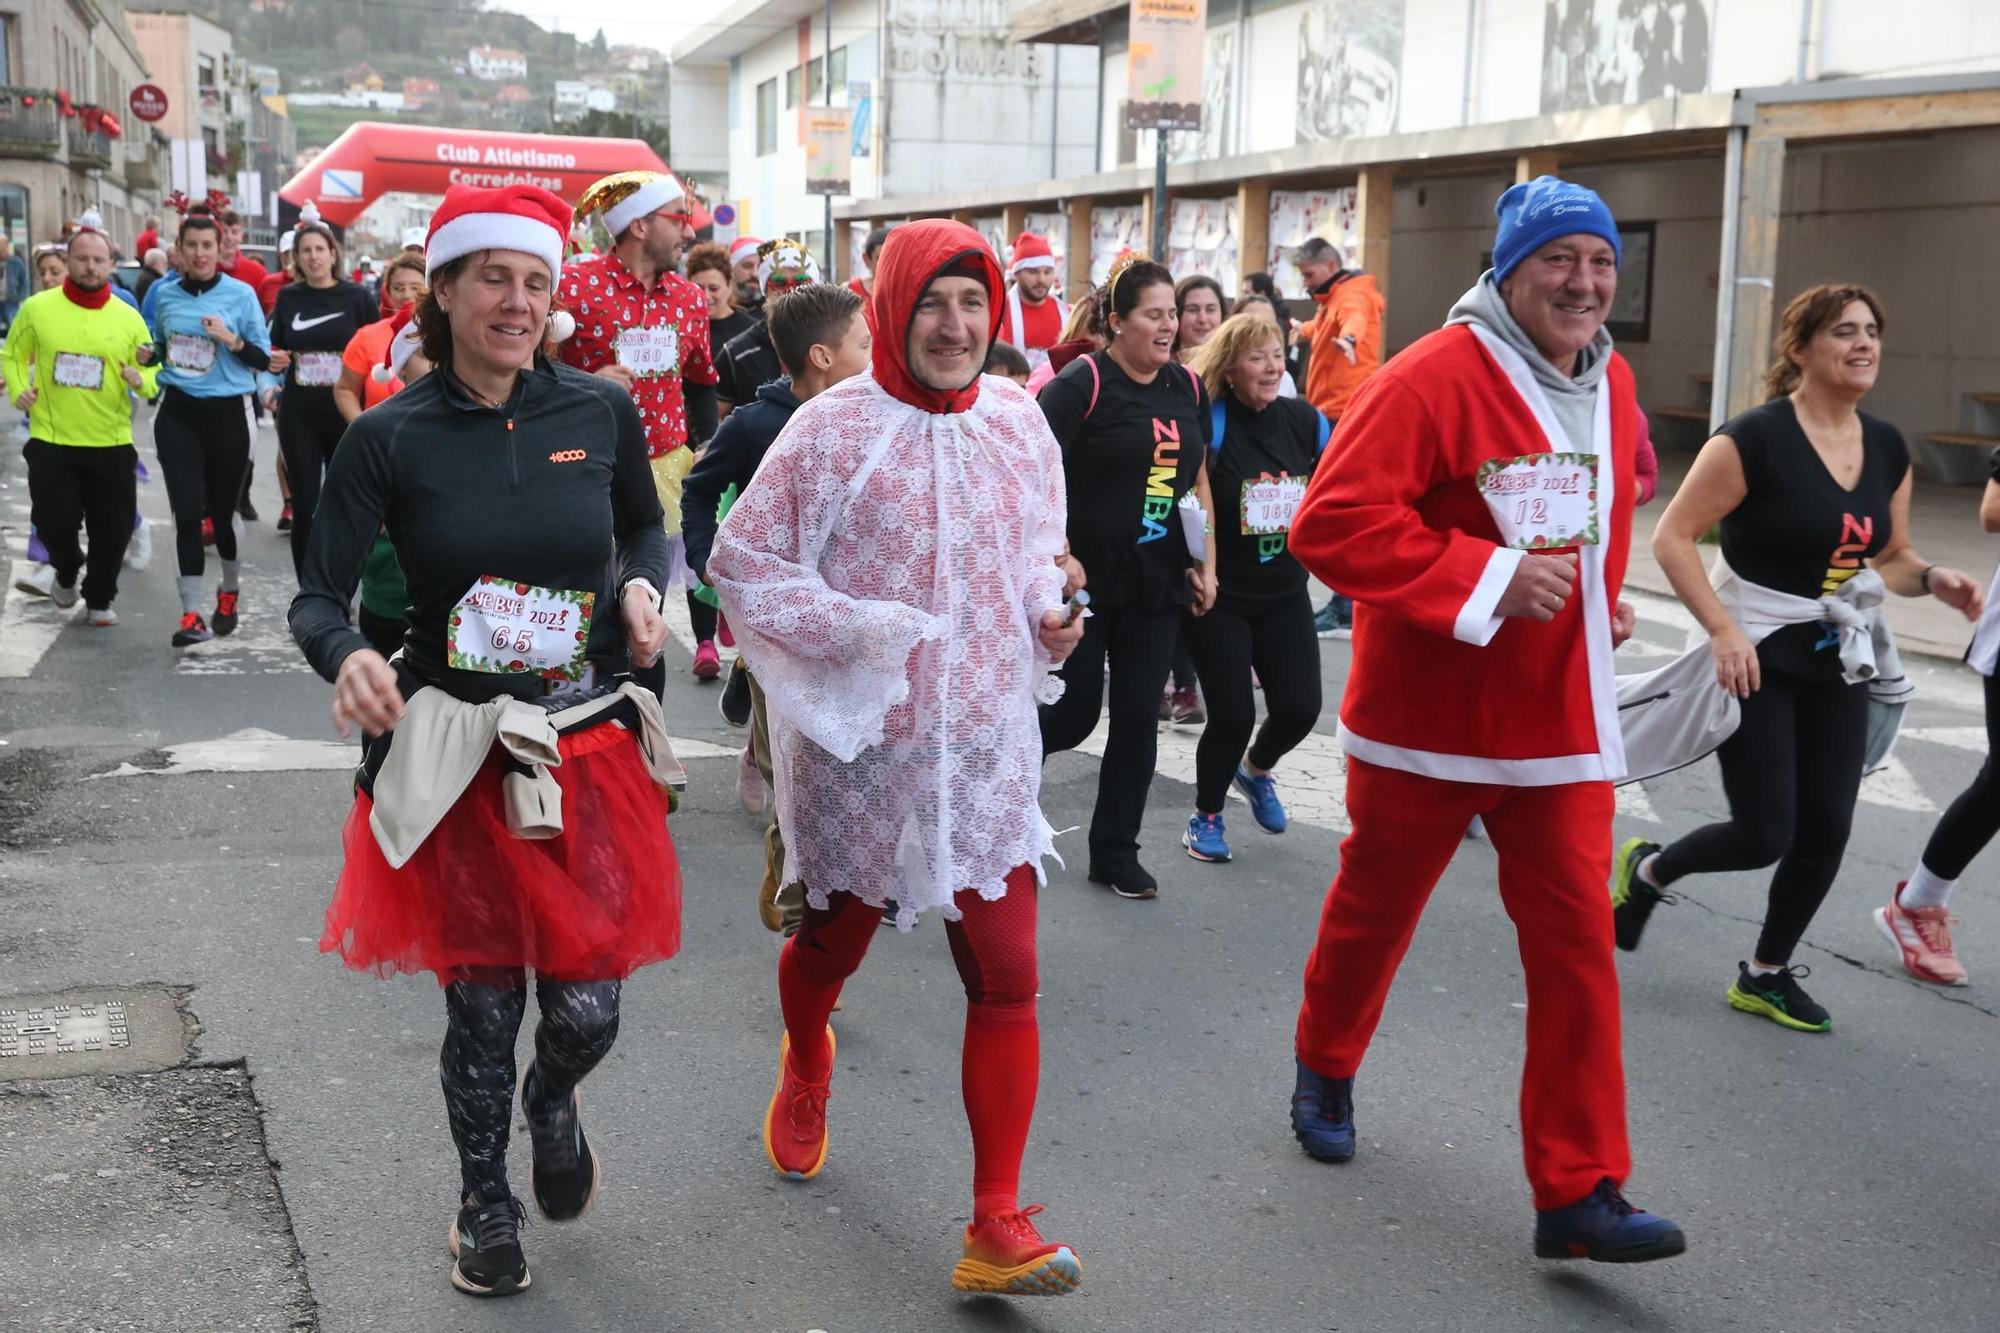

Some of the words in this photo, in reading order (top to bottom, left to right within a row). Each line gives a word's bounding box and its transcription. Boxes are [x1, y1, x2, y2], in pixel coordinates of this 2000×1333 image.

[895, 49, 949, 75] DO
[956, 49, 1042, 78] MAR
[436, 143, 480, 162] Club
[484, 147, 576, 168] Atletismo
[449, 169, 562, 191] Corredoiras
[633, 348, 662, 363] 150
[1137, 417, 1181, 544] ZUMBA
[1543, 473, 1580, 490] 2023
[1515, 498, 1548, 525] 12
[529, 609, 569, 626] 2023
[491, 625, 534, 653] 65
